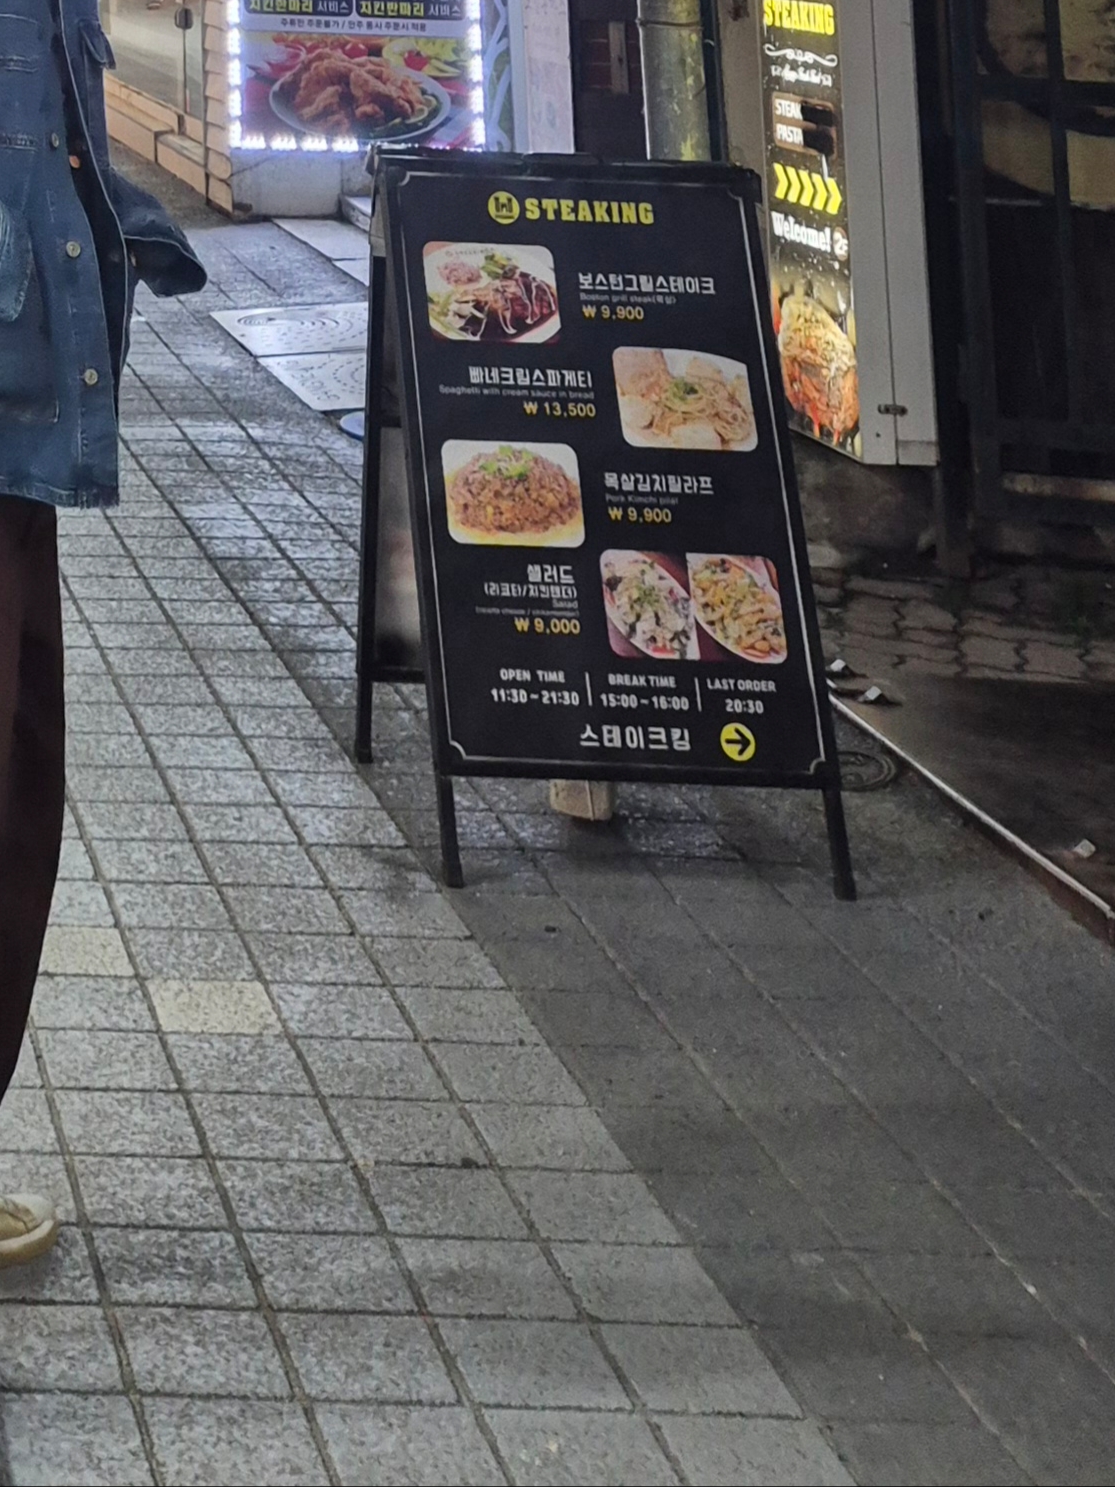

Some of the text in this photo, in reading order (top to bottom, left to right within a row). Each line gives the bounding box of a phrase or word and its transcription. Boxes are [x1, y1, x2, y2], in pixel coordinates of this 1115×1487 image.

[316, 0, 350, 14] 서비스
[359, 1, 462, 18] 치킨반마리 서비스
[774, 98, 803, 121] STEAK
[525, 198, 655, 225] STEAKING
[771, 211, 831, 253] Welcome!
[578, 272, 716, 294] 보스턴그릴스테이크
[468, 366, 593, 388] 빠네크림스파게티
[604, 472, 714, 495] 목살김치필라프
[527, 564, 575, 584] 샐러드
[500, 669, 565, 683] OPEN TIME
[608, 674, 676, 688] BREAK TIME
[706, 678, 777, 692] LAST ORDER
[725, 698, 765, 714] 20:30
